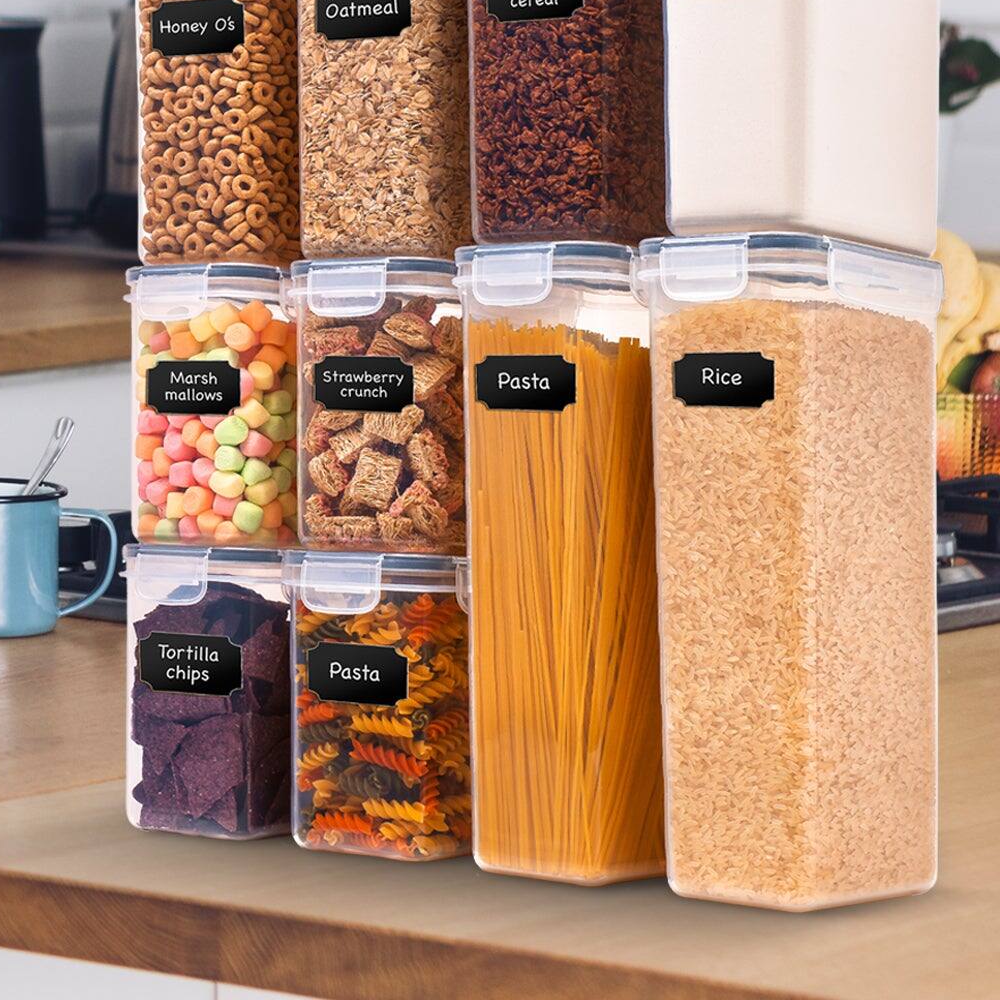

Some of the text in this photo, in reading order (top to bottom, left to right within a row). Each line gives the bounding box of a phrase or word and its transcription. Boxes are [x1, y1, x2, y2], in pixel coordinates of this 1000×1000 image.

[159, 15, 236, 36] Honey O's
[170, 370, 218, 385] Marsh
[322, 370, 404, 388] Strawberry
[497, 371, 551, 390] Pasta
[701, 367, 743, 386] Rice
[163, 387, 223, 402] mallows
[340, 385, 388, 398] crunch
[158, 644, 220, 662] Tortilla
[166, 664, 210, 686] chips
[329, 661, 381, 682] Pasta
